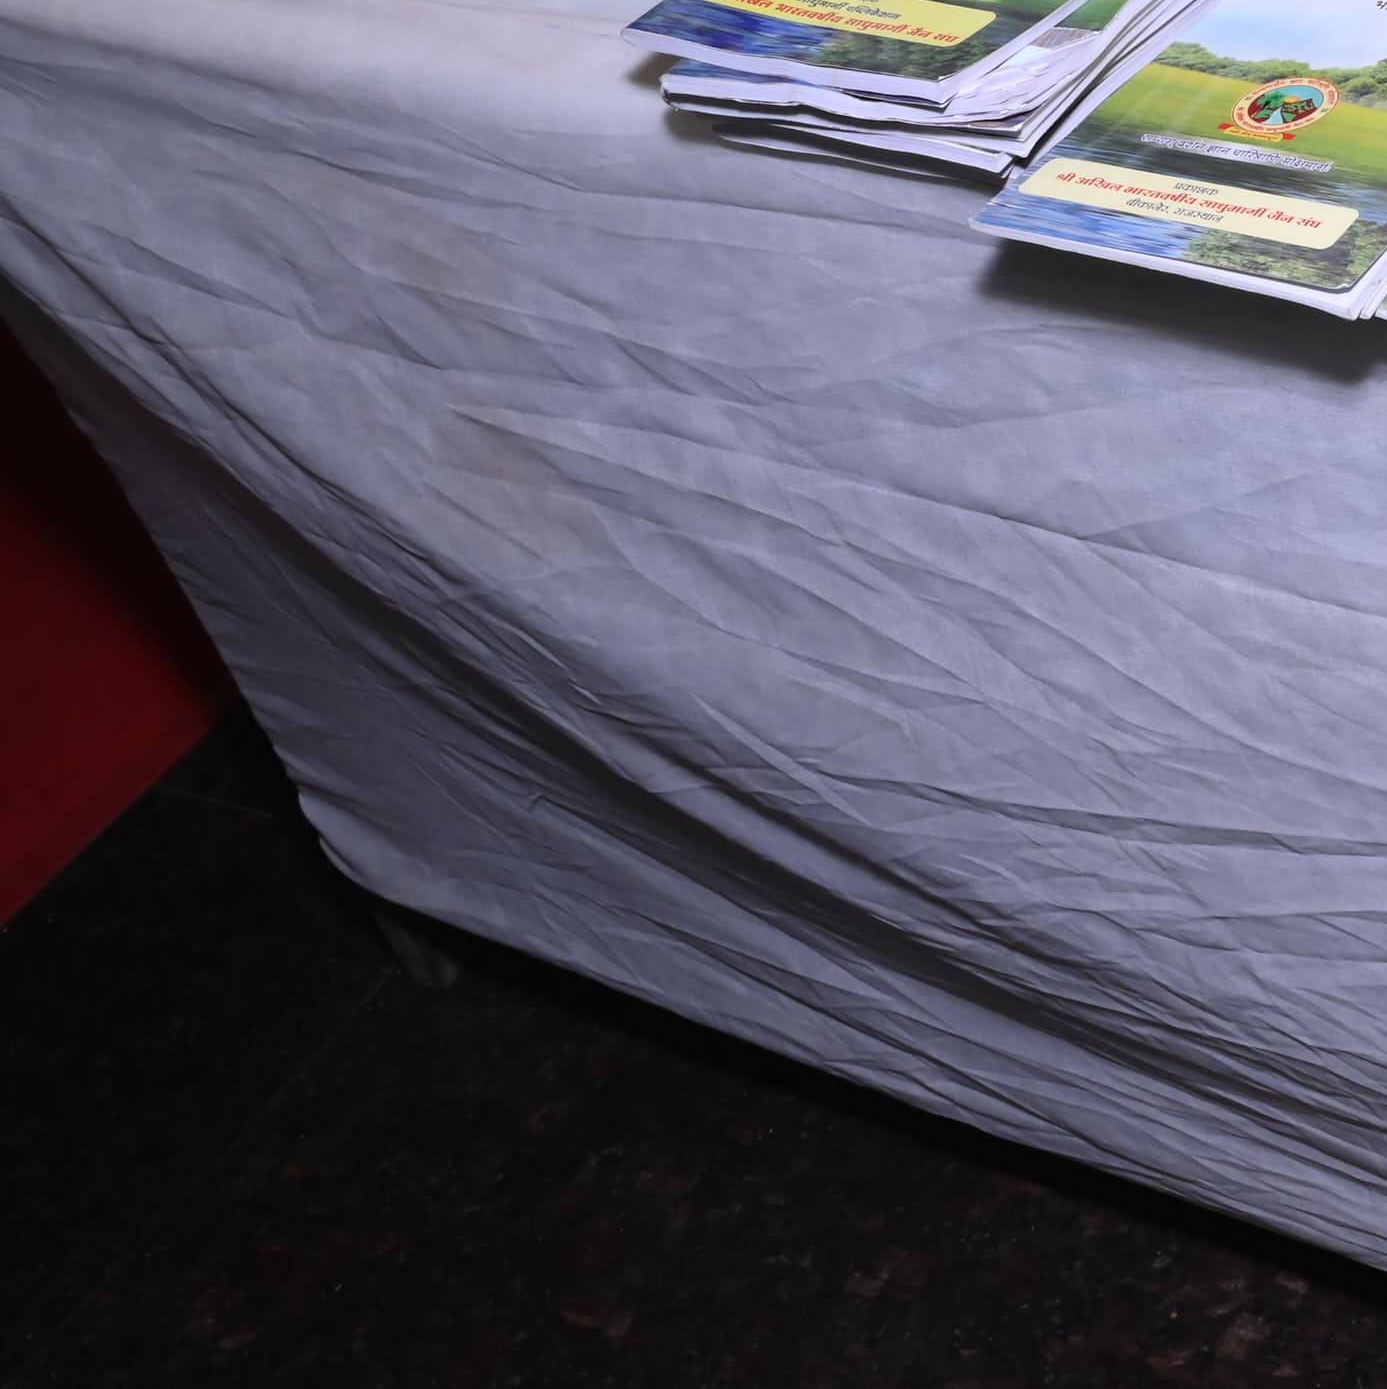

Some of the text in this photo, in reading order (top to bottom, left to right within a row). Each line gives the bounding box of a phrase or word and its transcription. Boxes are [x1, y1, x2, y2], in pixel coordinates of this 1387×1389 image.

[1056, 172, 1075, 183] श्री
[1075, 176, 1122, 192] अखिल
[1266, 208, 1294, 223] जैन
[1174, 181, 1220, 196] प्रकाशक
